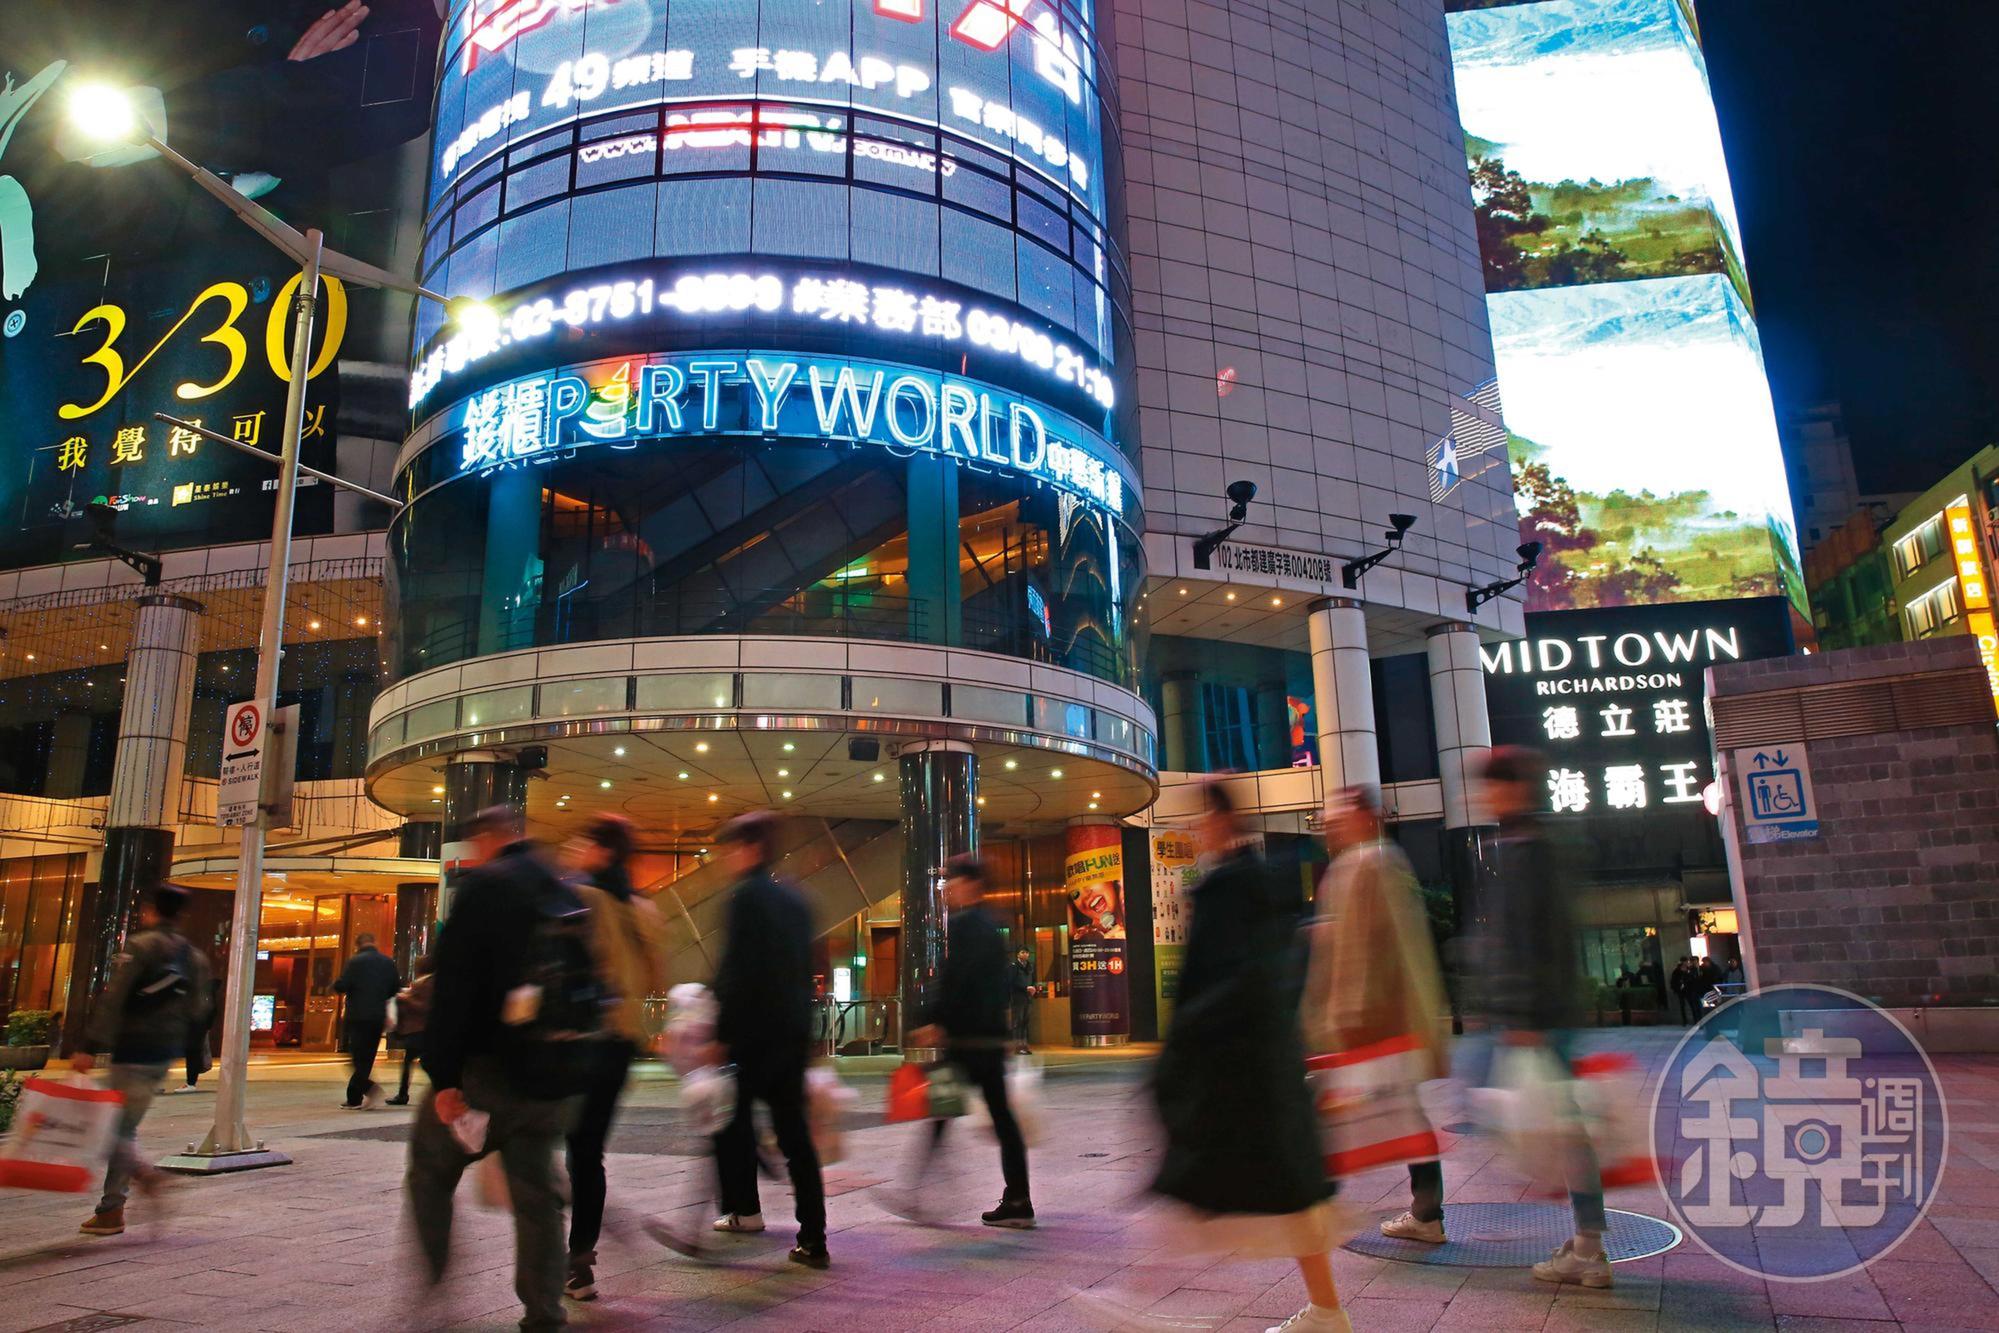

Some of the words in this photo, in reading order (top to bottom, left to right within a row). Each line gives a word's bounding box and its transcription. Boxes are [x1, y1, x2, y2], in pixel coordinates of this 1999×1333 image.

[58, 272, 347, 419] 3/30
[58, 405, 325, 471] 我覺得可以
[461, 379, 547, 469] 錢櫃
[1480, 626, 1740, 674] MIDTOWN
[1537, 673, 1682, 695] RICHARDSON
[1543, 698, 1691, 739] 德立莊
[1547, 761, 1704, 813] 海霸王
[1781, 829, 1818, 839] Elevator
